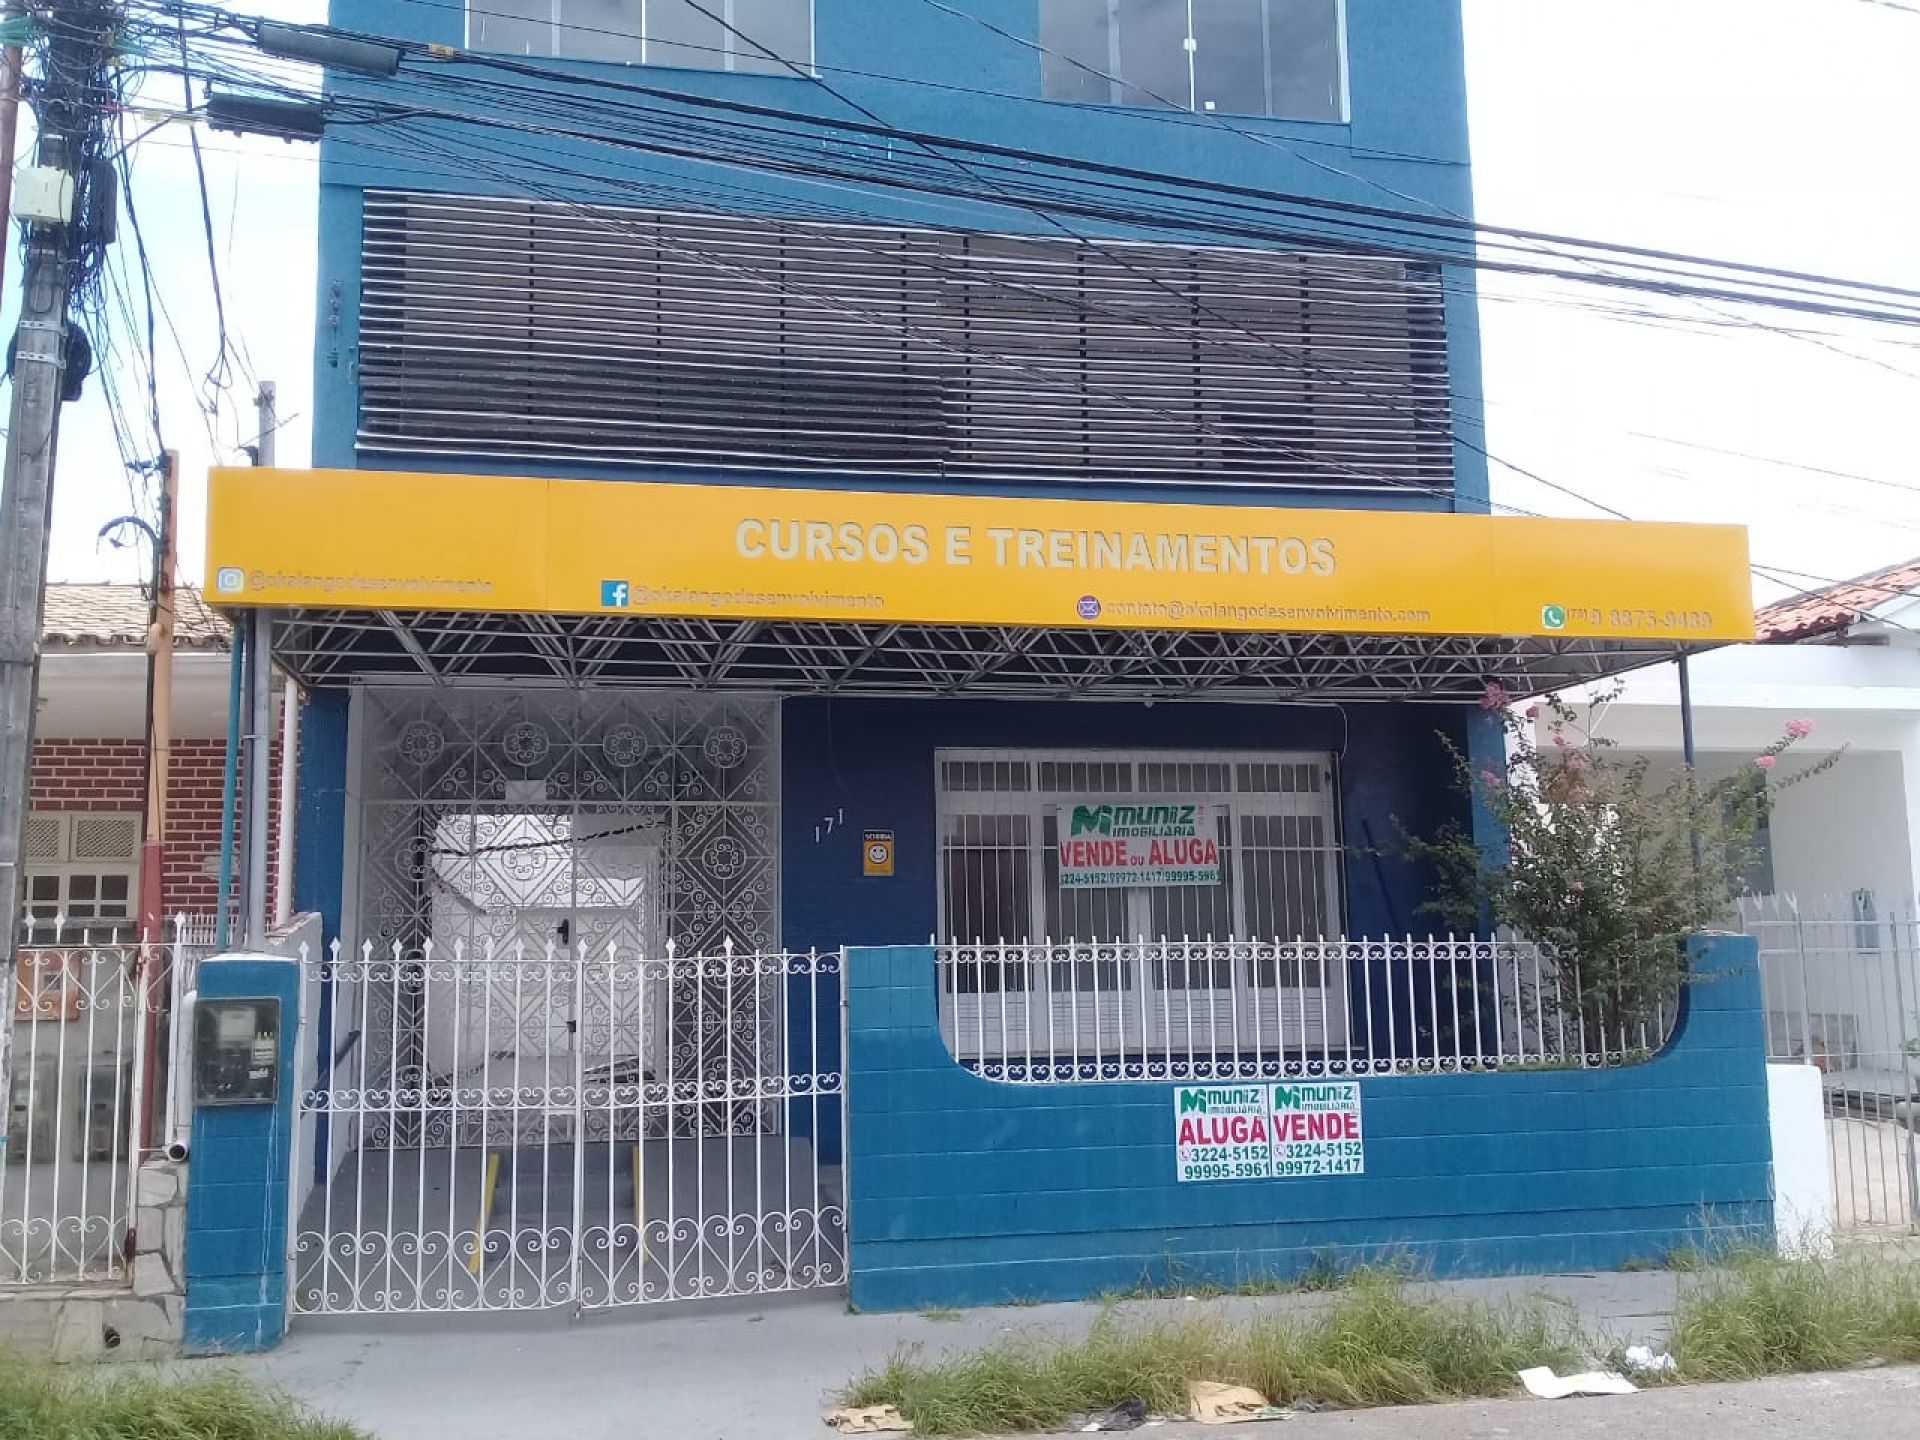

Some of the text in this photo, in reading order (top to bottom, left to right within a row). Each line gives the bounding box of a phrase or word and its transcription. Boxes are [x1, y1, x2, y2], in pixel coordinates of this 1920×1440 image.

[735, 518, 1338, 577] CURSOS E TREINAMENTOS
[1060, 839, 1128, 867] VENDE
[1148, 838, 1218, 865] ALUGA
[1178, 1115, 1267, 1146] ALUGA
[1273, 1112, 1360, 1142] VENDE
[1192, 1145, 1268, 1162] 3224-5152
[1286, 1141, 1362, 1158] 3224-5152
[1184, 1162, 1270, 1179] 99995-5961
[1276, 1157, 1361, 1175] 99972-1417
